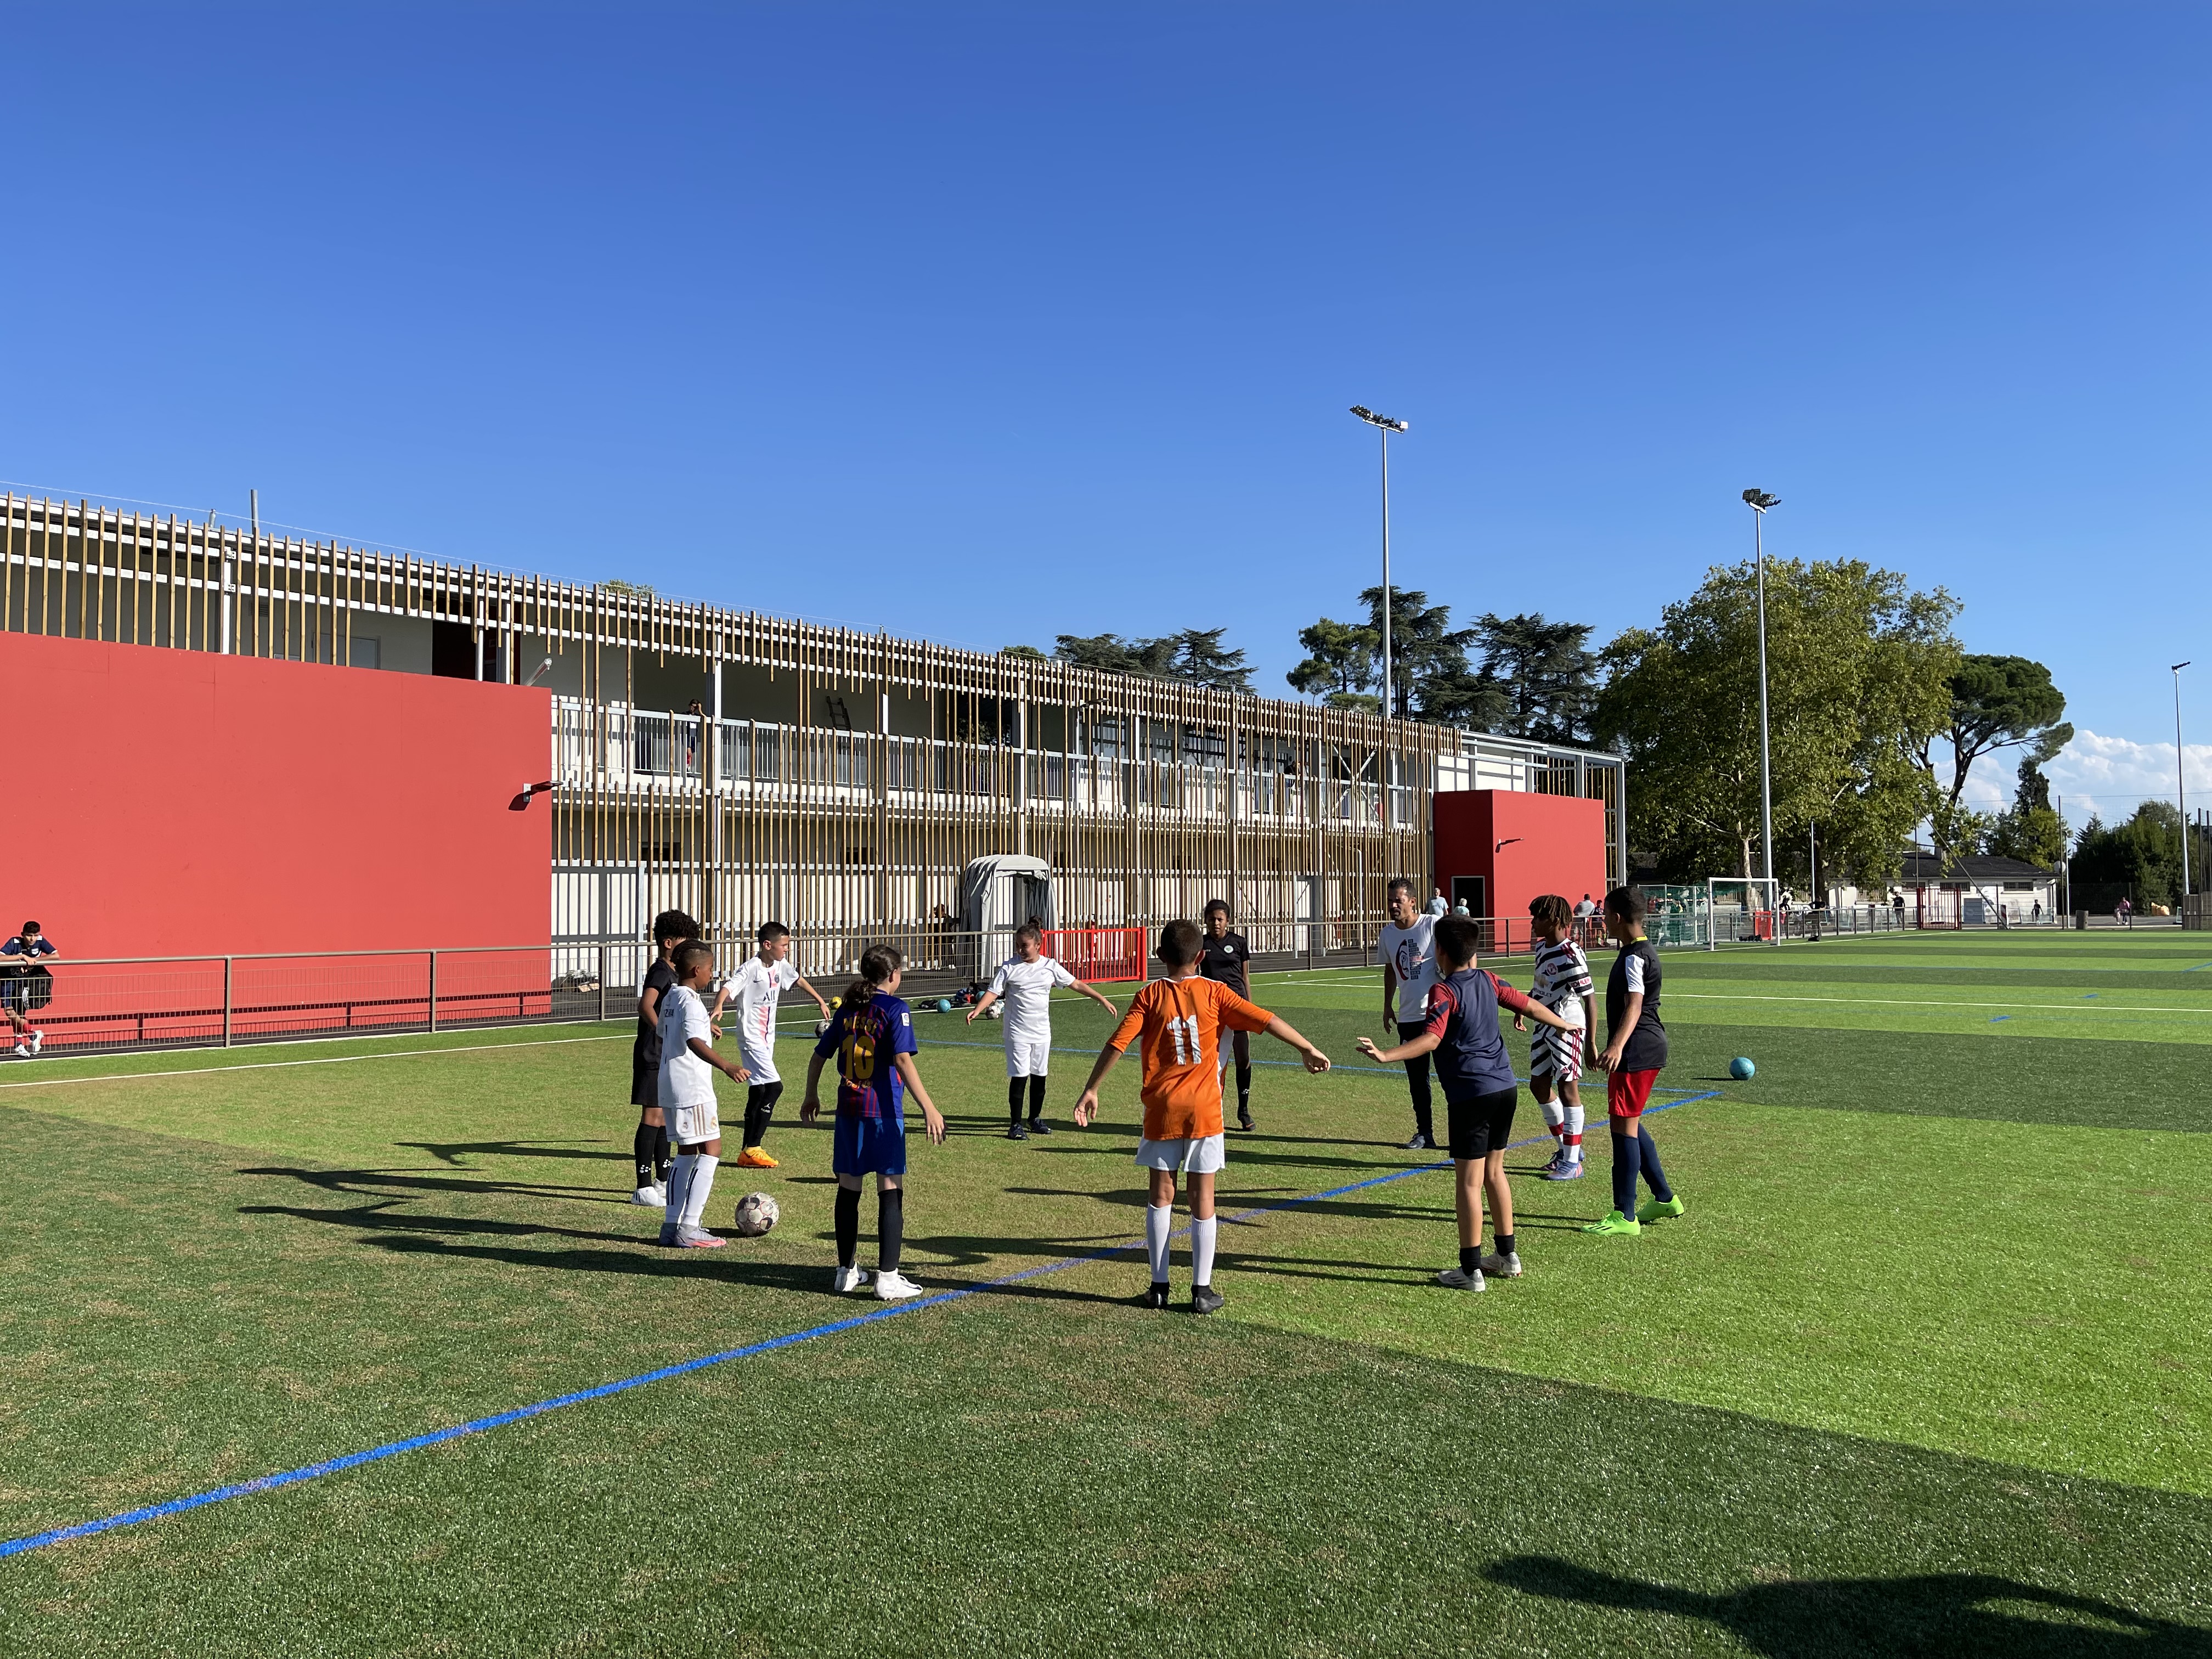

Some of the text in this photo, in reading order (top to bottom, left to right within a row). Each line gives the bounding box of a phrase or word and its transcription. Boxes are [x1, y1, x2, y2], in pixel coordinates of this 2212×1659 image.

[843, 1016, 878, 1034] MESSI
[1166, 1014, 1202, 1065] 11
[842, 1034, 874, 1080] 10
